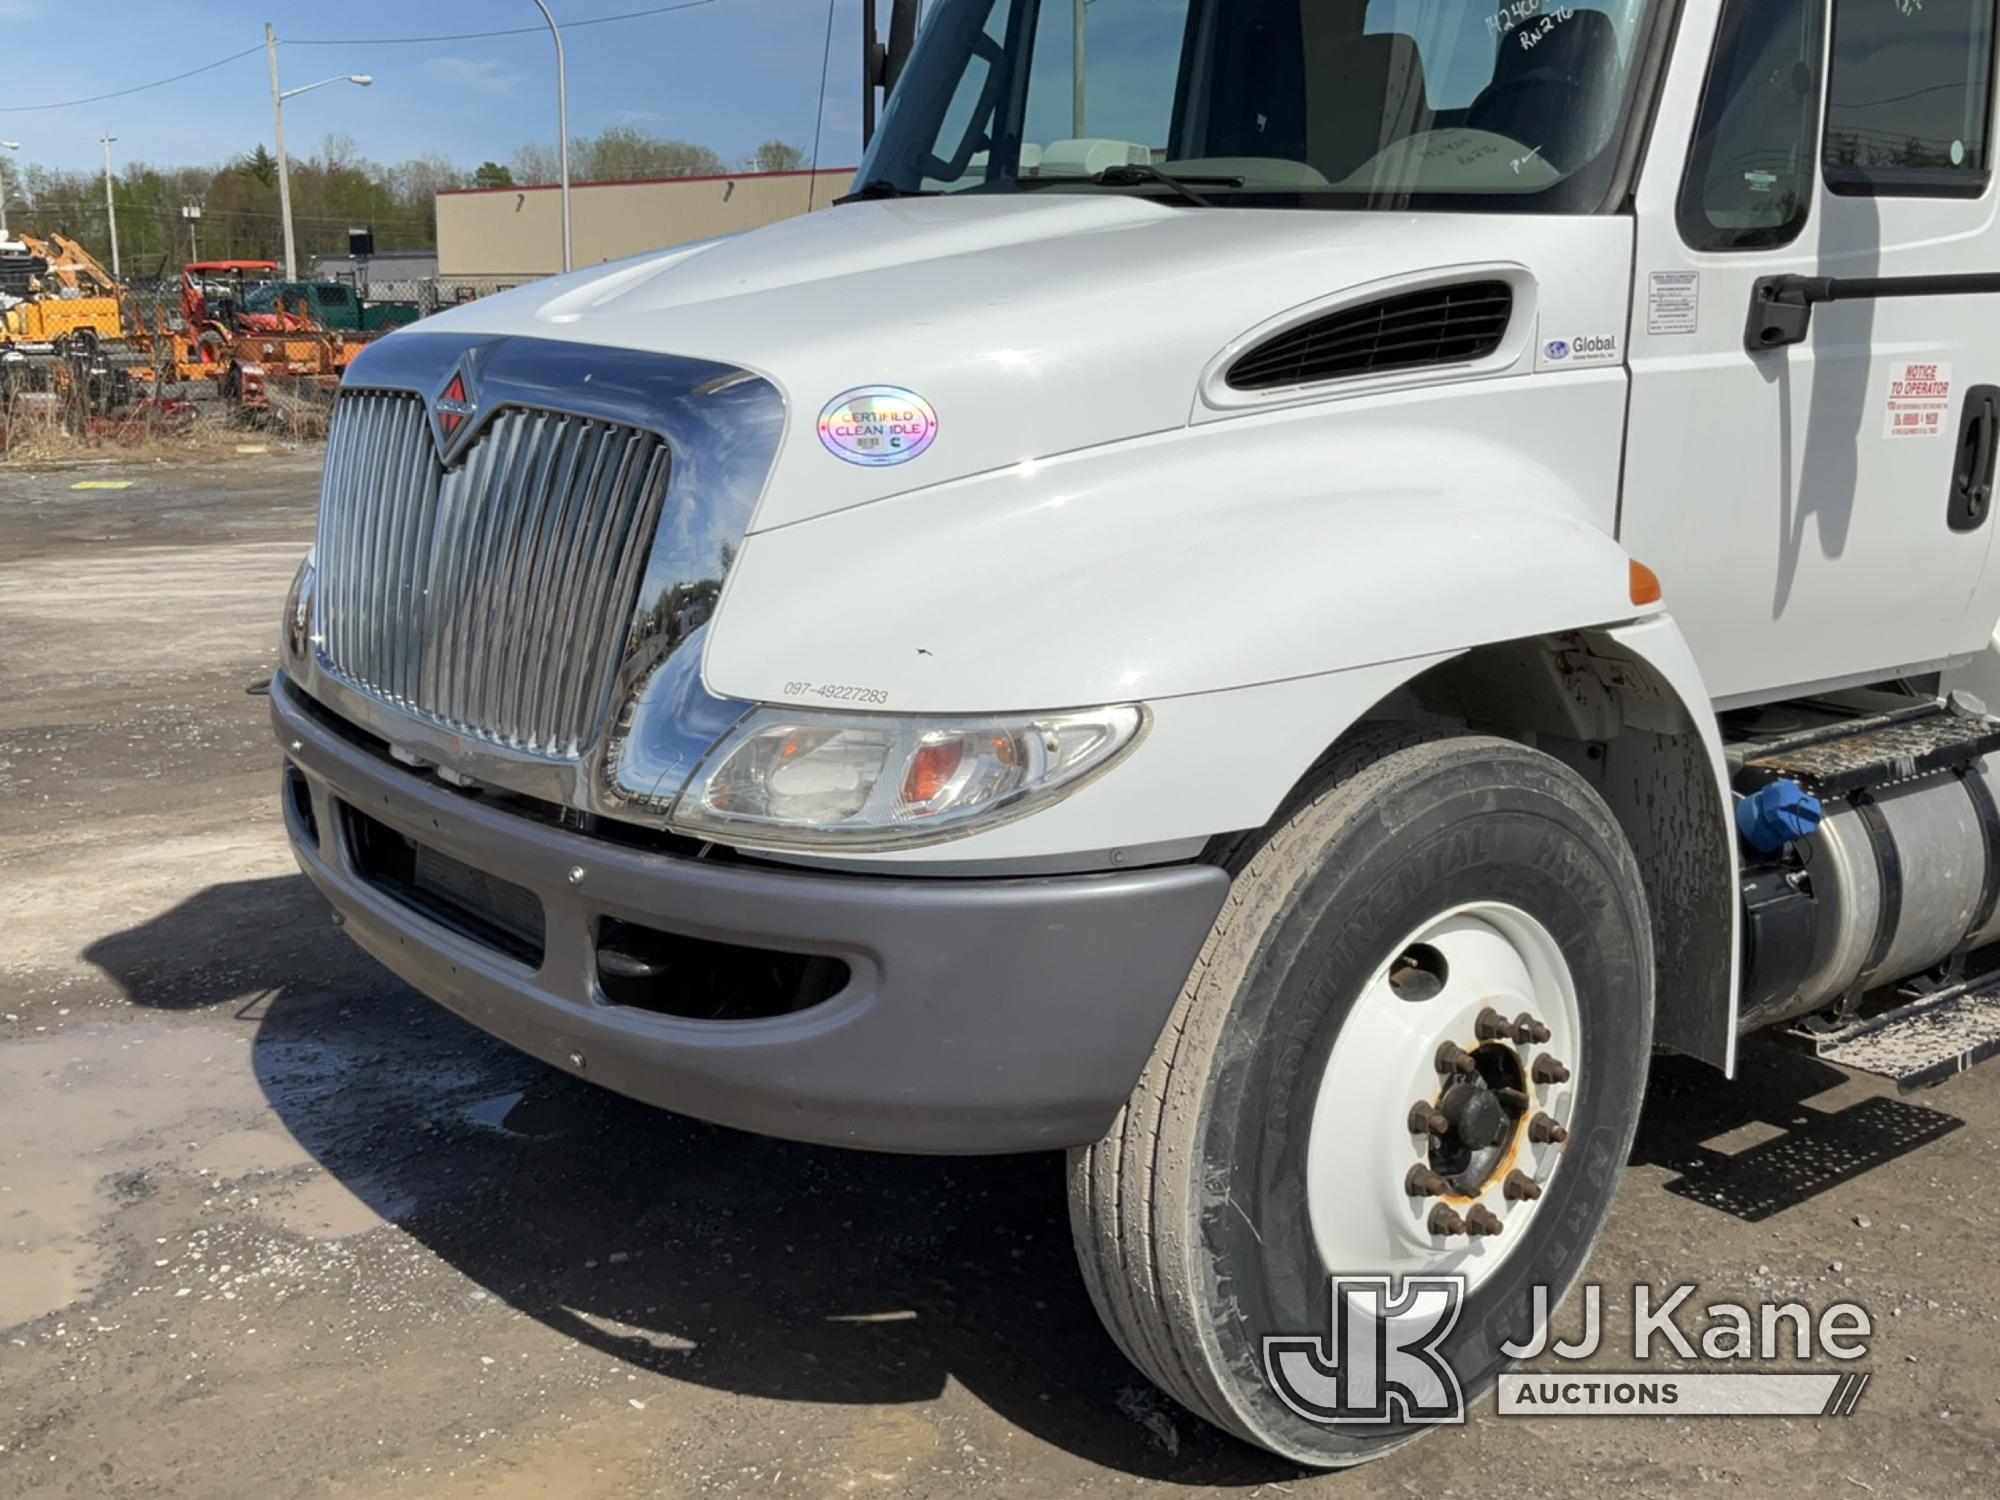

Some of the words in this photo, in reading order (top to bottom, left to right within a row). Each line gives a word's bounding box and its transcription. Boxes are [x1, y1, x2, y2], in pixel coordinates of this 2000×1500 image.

[1572, 335, 1615, 353] Global
[1905, 365, 1937, 378] NOTICE
[1891, 381, 1903, 395] TO
[1904, 381, 1949, 394] OPERATOR
[841, 411, 914, 423] CERTIFIED
[835, 424, 884, 436] CLEAN
[889, 423, 921, 434] IDLE
[783, 681, 889, 704] 097-49227283
